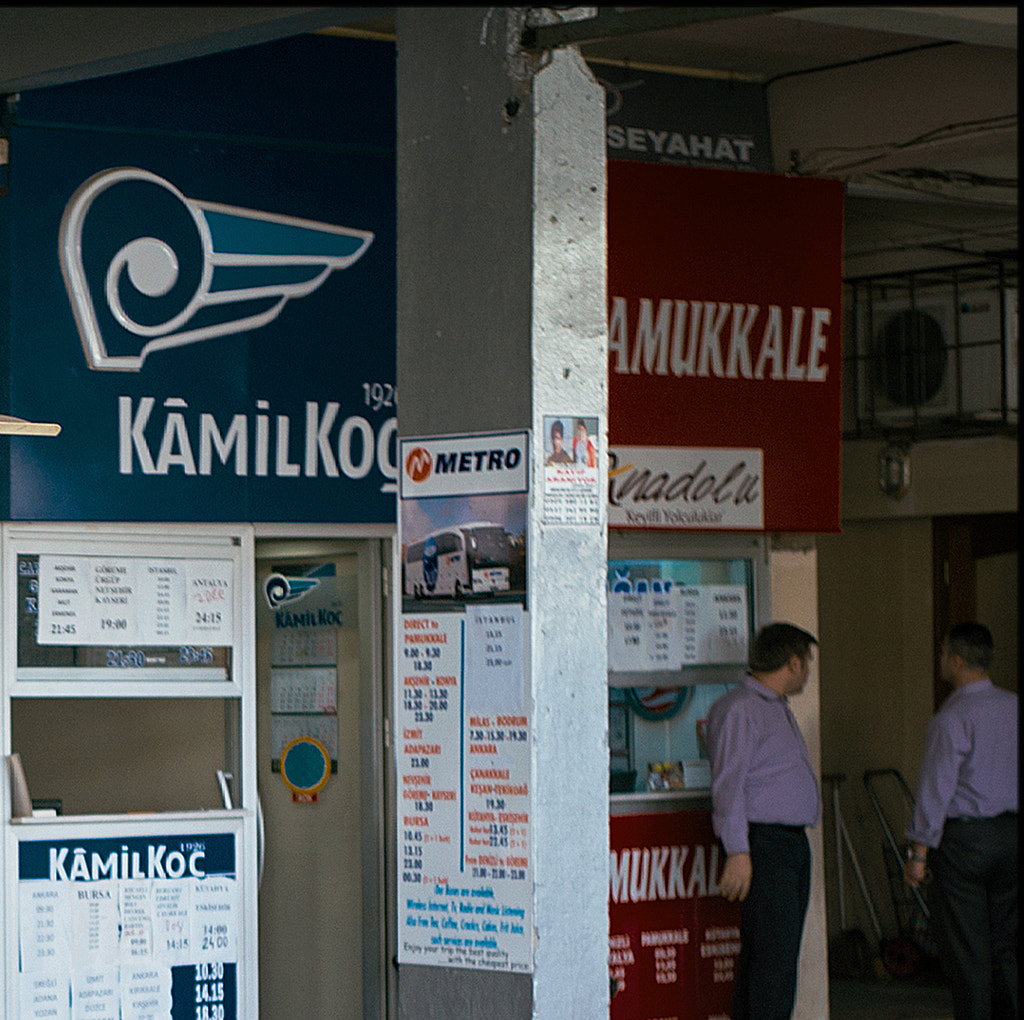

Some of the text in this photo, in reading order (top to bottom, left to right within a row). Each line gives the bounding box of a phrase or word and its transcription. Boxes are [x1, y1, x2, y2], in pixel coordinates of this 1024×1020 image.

[607, 124, 754, 163] SEYAHAT
[435, 447, 522, 475] METRO
[51, 623, 77, 634] 21:45
[101, 618, 127, 629] 19:00
[78, 889, 112, 900] BURSA
[195, 964, 225, 981] 10.30
[195, 983, 225, 1003] 14.15
